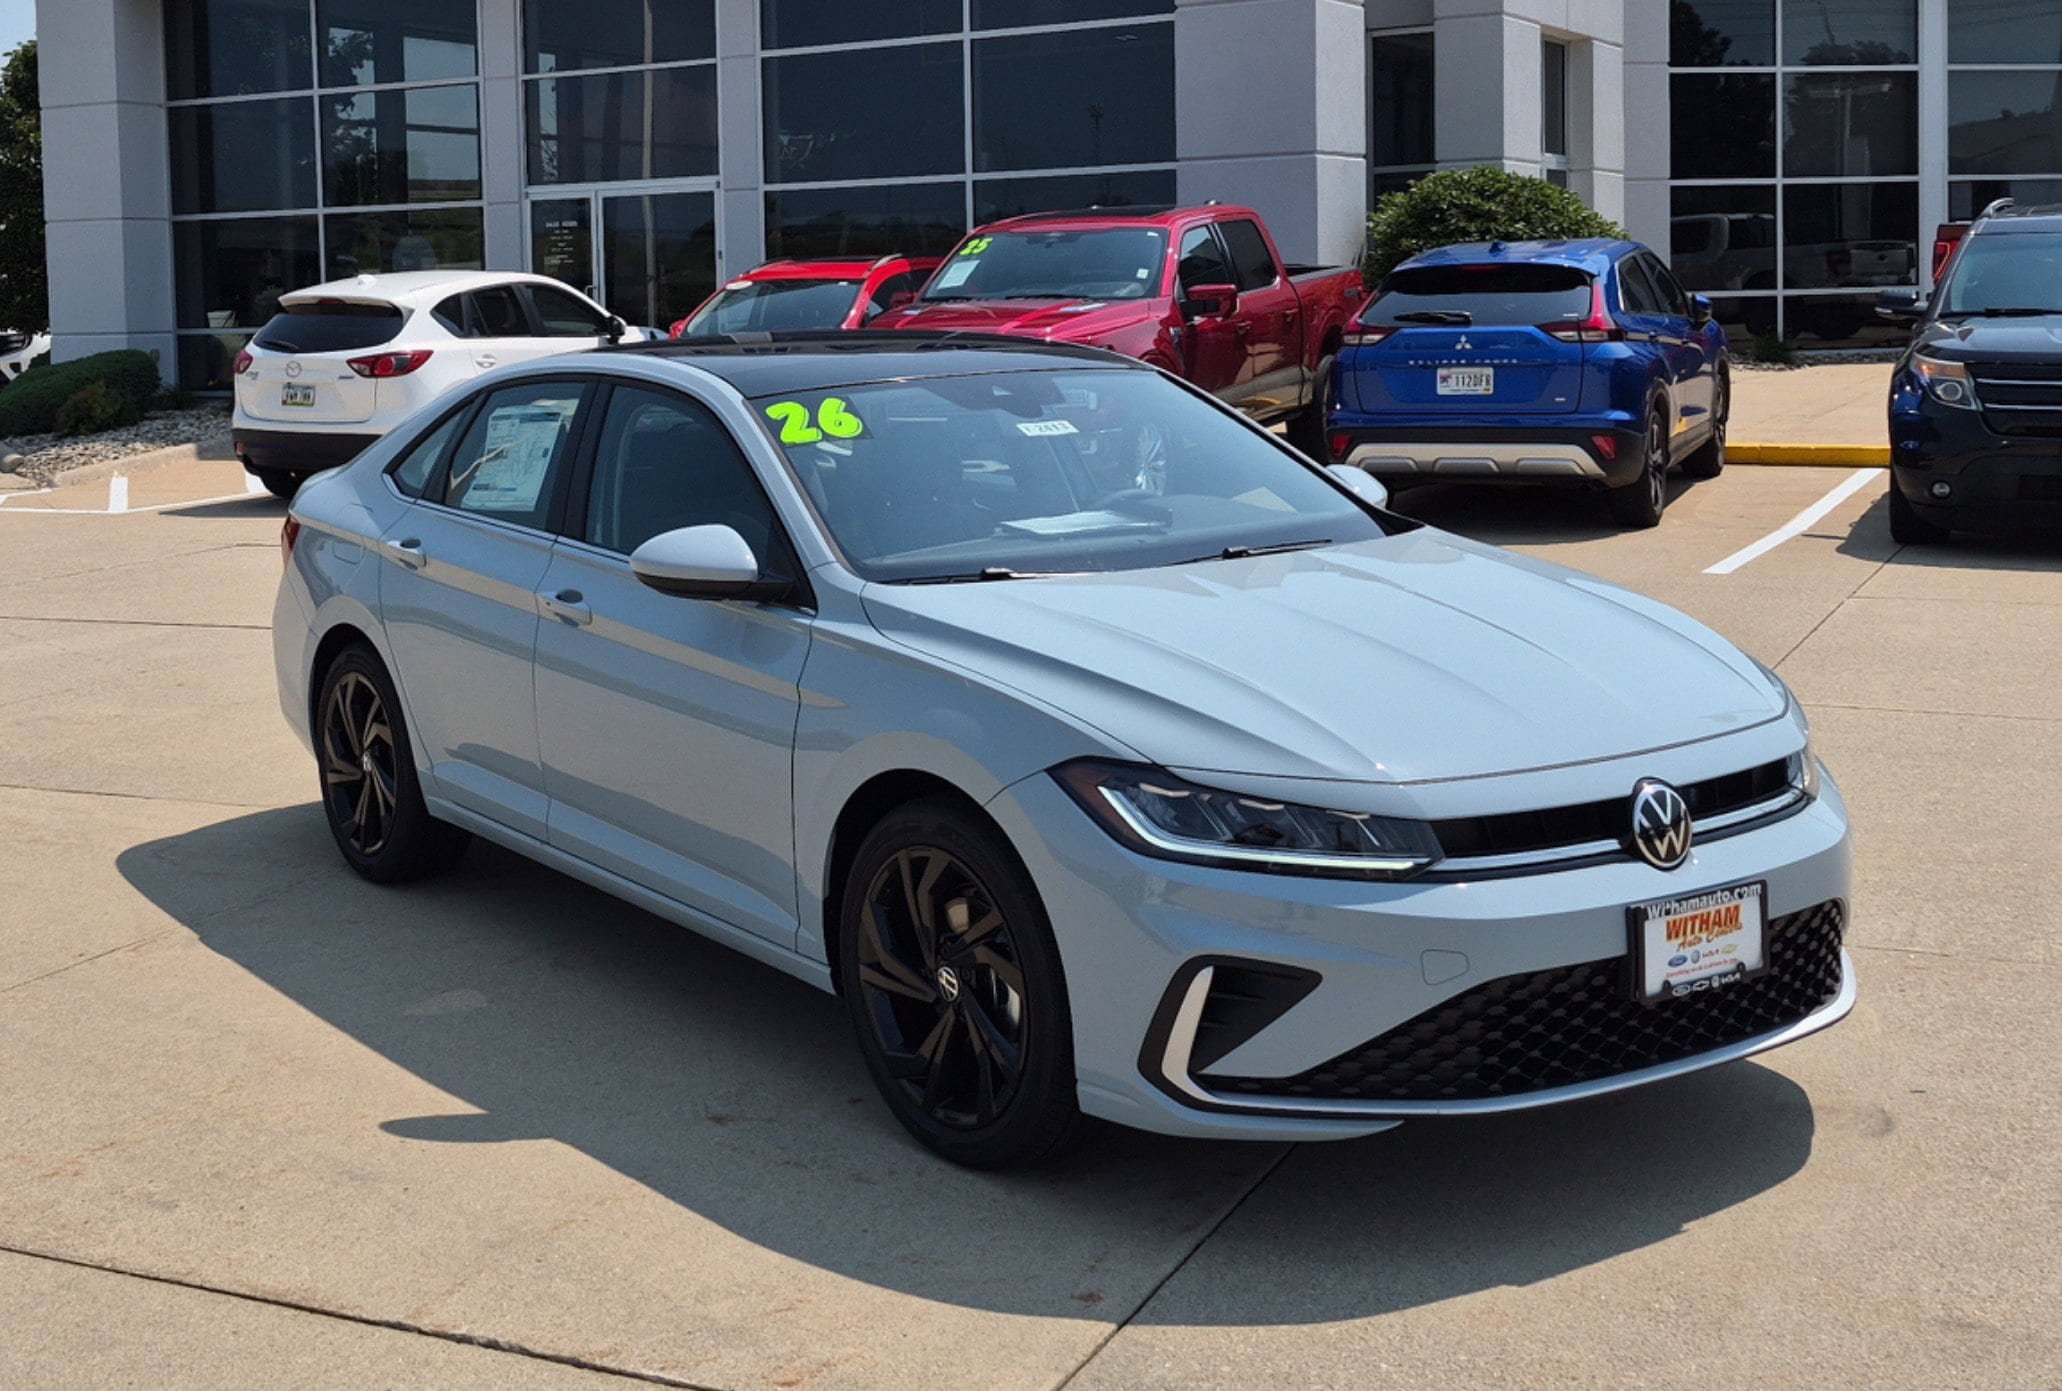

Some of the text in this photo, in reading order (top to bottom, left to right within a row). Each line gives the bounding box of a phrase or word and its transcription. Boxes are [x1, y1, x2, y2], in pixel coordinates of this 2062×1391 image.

[959, 237, 993, 256] 25
[765, 397, 863, 444] 26
[1666, 903, 1742, 942] WITHAM
